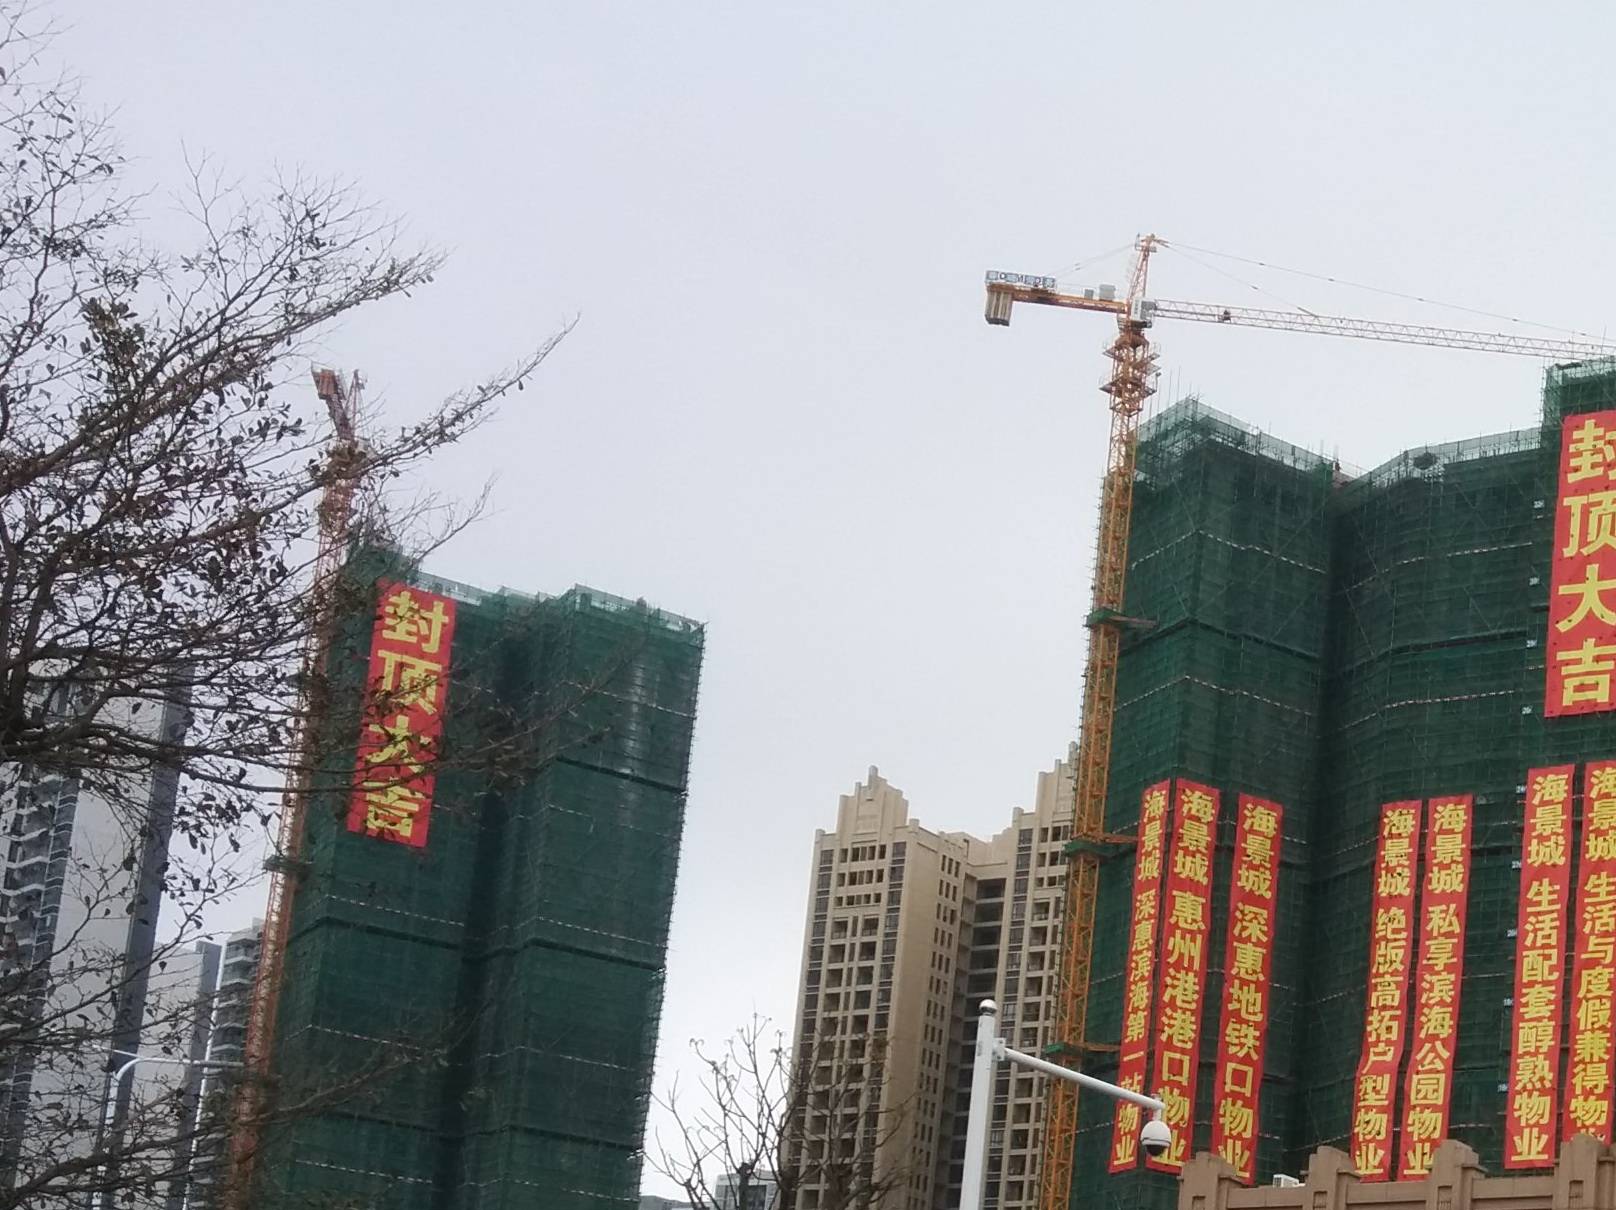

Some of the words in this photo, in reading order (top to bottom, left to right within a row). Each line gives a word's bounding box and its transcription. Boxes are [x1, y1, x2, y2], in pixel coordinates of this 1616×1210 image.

[363, 590, 449, 837] 封顶大吉
[1138, 788, 1164, 881] 海景城
[1174, 789, 1214, 884] 海景城
[1239, 806, 1277, 898] 海景城
[1378, 809, 1415, 897] 海景城
[1428, 804, 1466, 893] 海景城
[1527, 773, 1567, 866] 海景城
[1154, 890, 1206, 1168] 惠州港港口物业
[1217, 902, 1268, 1178] 深惠地铁口物业
[1354, 907, 1406, 1176] 绝版高拓户型物业
[1405, 904, 1460, 1175] 私享滨海公园物业
[1512, 878, 1560, 1162] 生活配套醇熟物业
